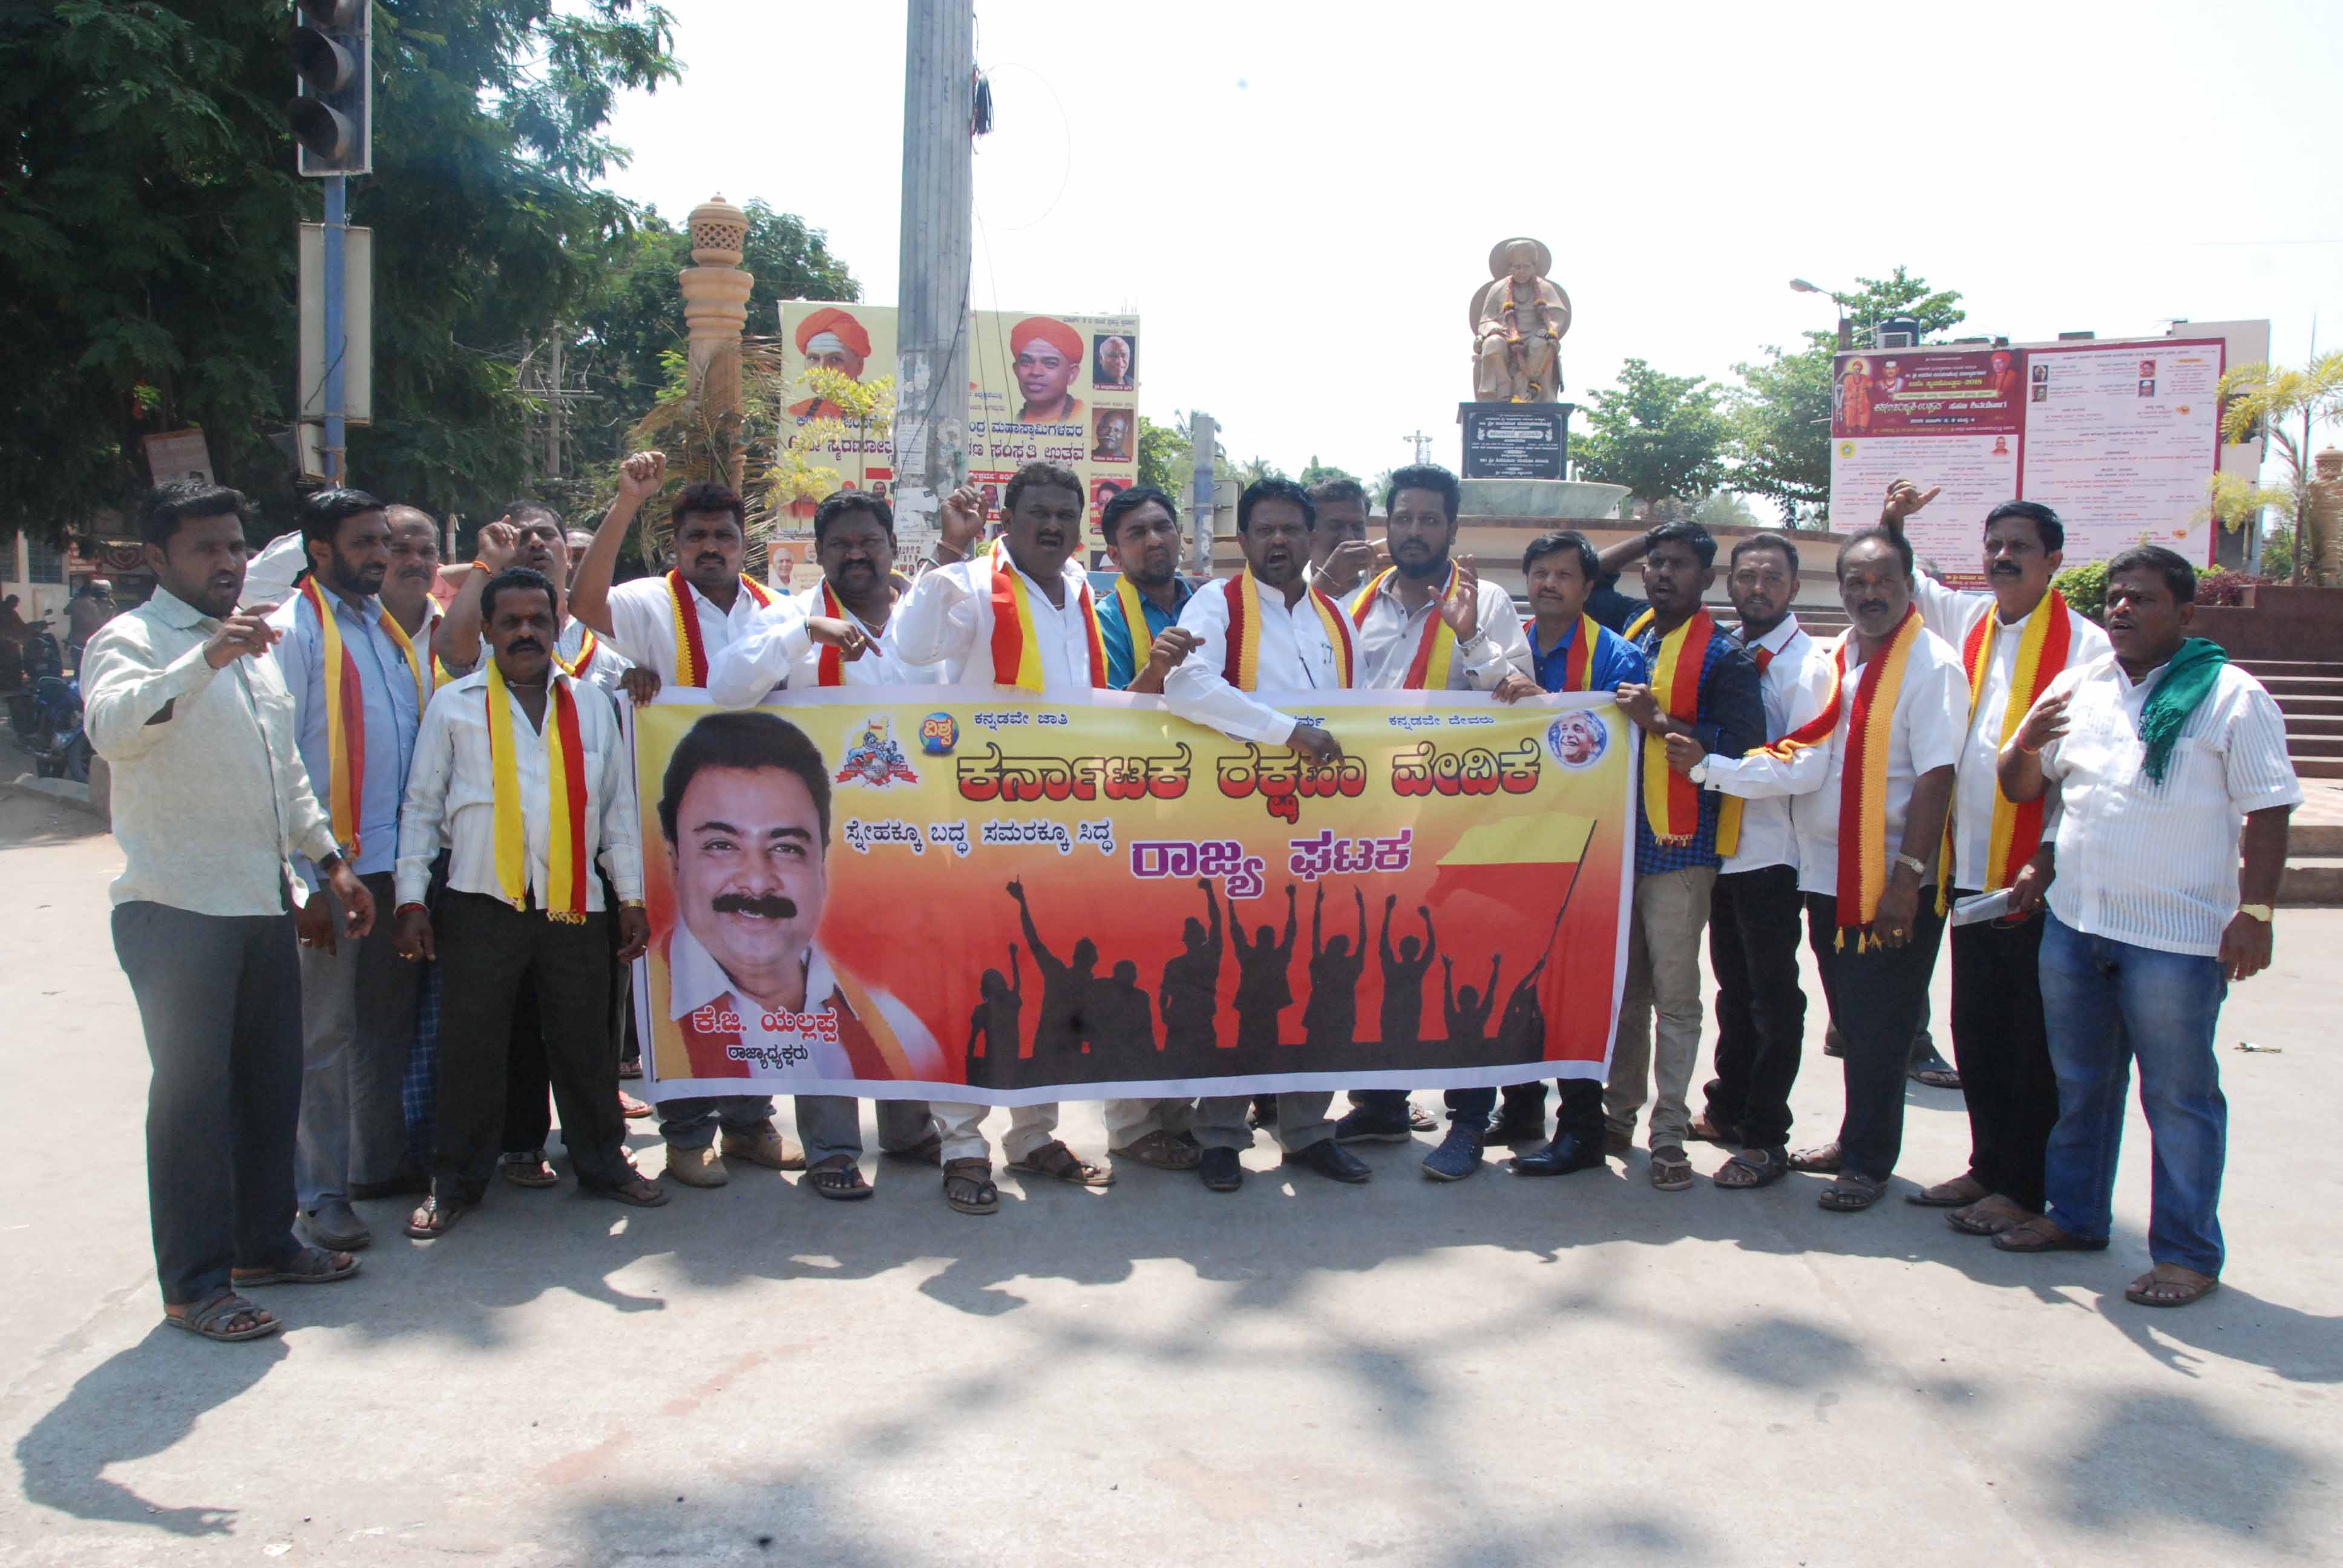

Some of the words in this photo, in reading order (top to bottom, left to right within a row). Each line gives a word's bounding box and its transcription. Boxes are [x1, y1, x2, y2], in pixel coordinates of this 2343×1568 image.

[923, 718, 953, 747] ವಿಶ್ವ
[974, 711, 1029, 730] ಕನ್ನಡವೇ
[1038, 713, 1068, 725] ಜಾತಿ
[1295, 716, 1325, 727] ರ್ಮ
[1389, 714, 1440, 731] ಕನ್ನಡವೇ
[1449, 715, 1495, 725] ದೇವರು
[957, 741, 1192, 802] ಕರ್ನಾಟಕ
[1216, 742, 1368, 825] ರಕ್ಷಣಾ
[1392, 737, 1541, 797] ವೇದಿಕೆ
[846, 820, 923, 852] ಸ್ನೇಹಕ್ಕೂ
[931, 822, 969, 854] ಬದ್ಧ
[983, 820, 1070, 852] ಸಮರಕ್ಕೂ
[1079, 820, 1113, 852] ಸಿದ್ಧ
[1131, 841, 1265, 898] ರಾಜ್ಯ
[1289, 829, 1412, 881] ಘಟಕ
[693, 1005, 748, 1032] ಕೆ.ಜಿ.
[760, 1007, 838, 1042] ಯಲ್ಲಪ್ಪ
[728, 1044, 808, 1070] ರಾಜ್ಯಾಧ್ಯಕ್ಷರು
